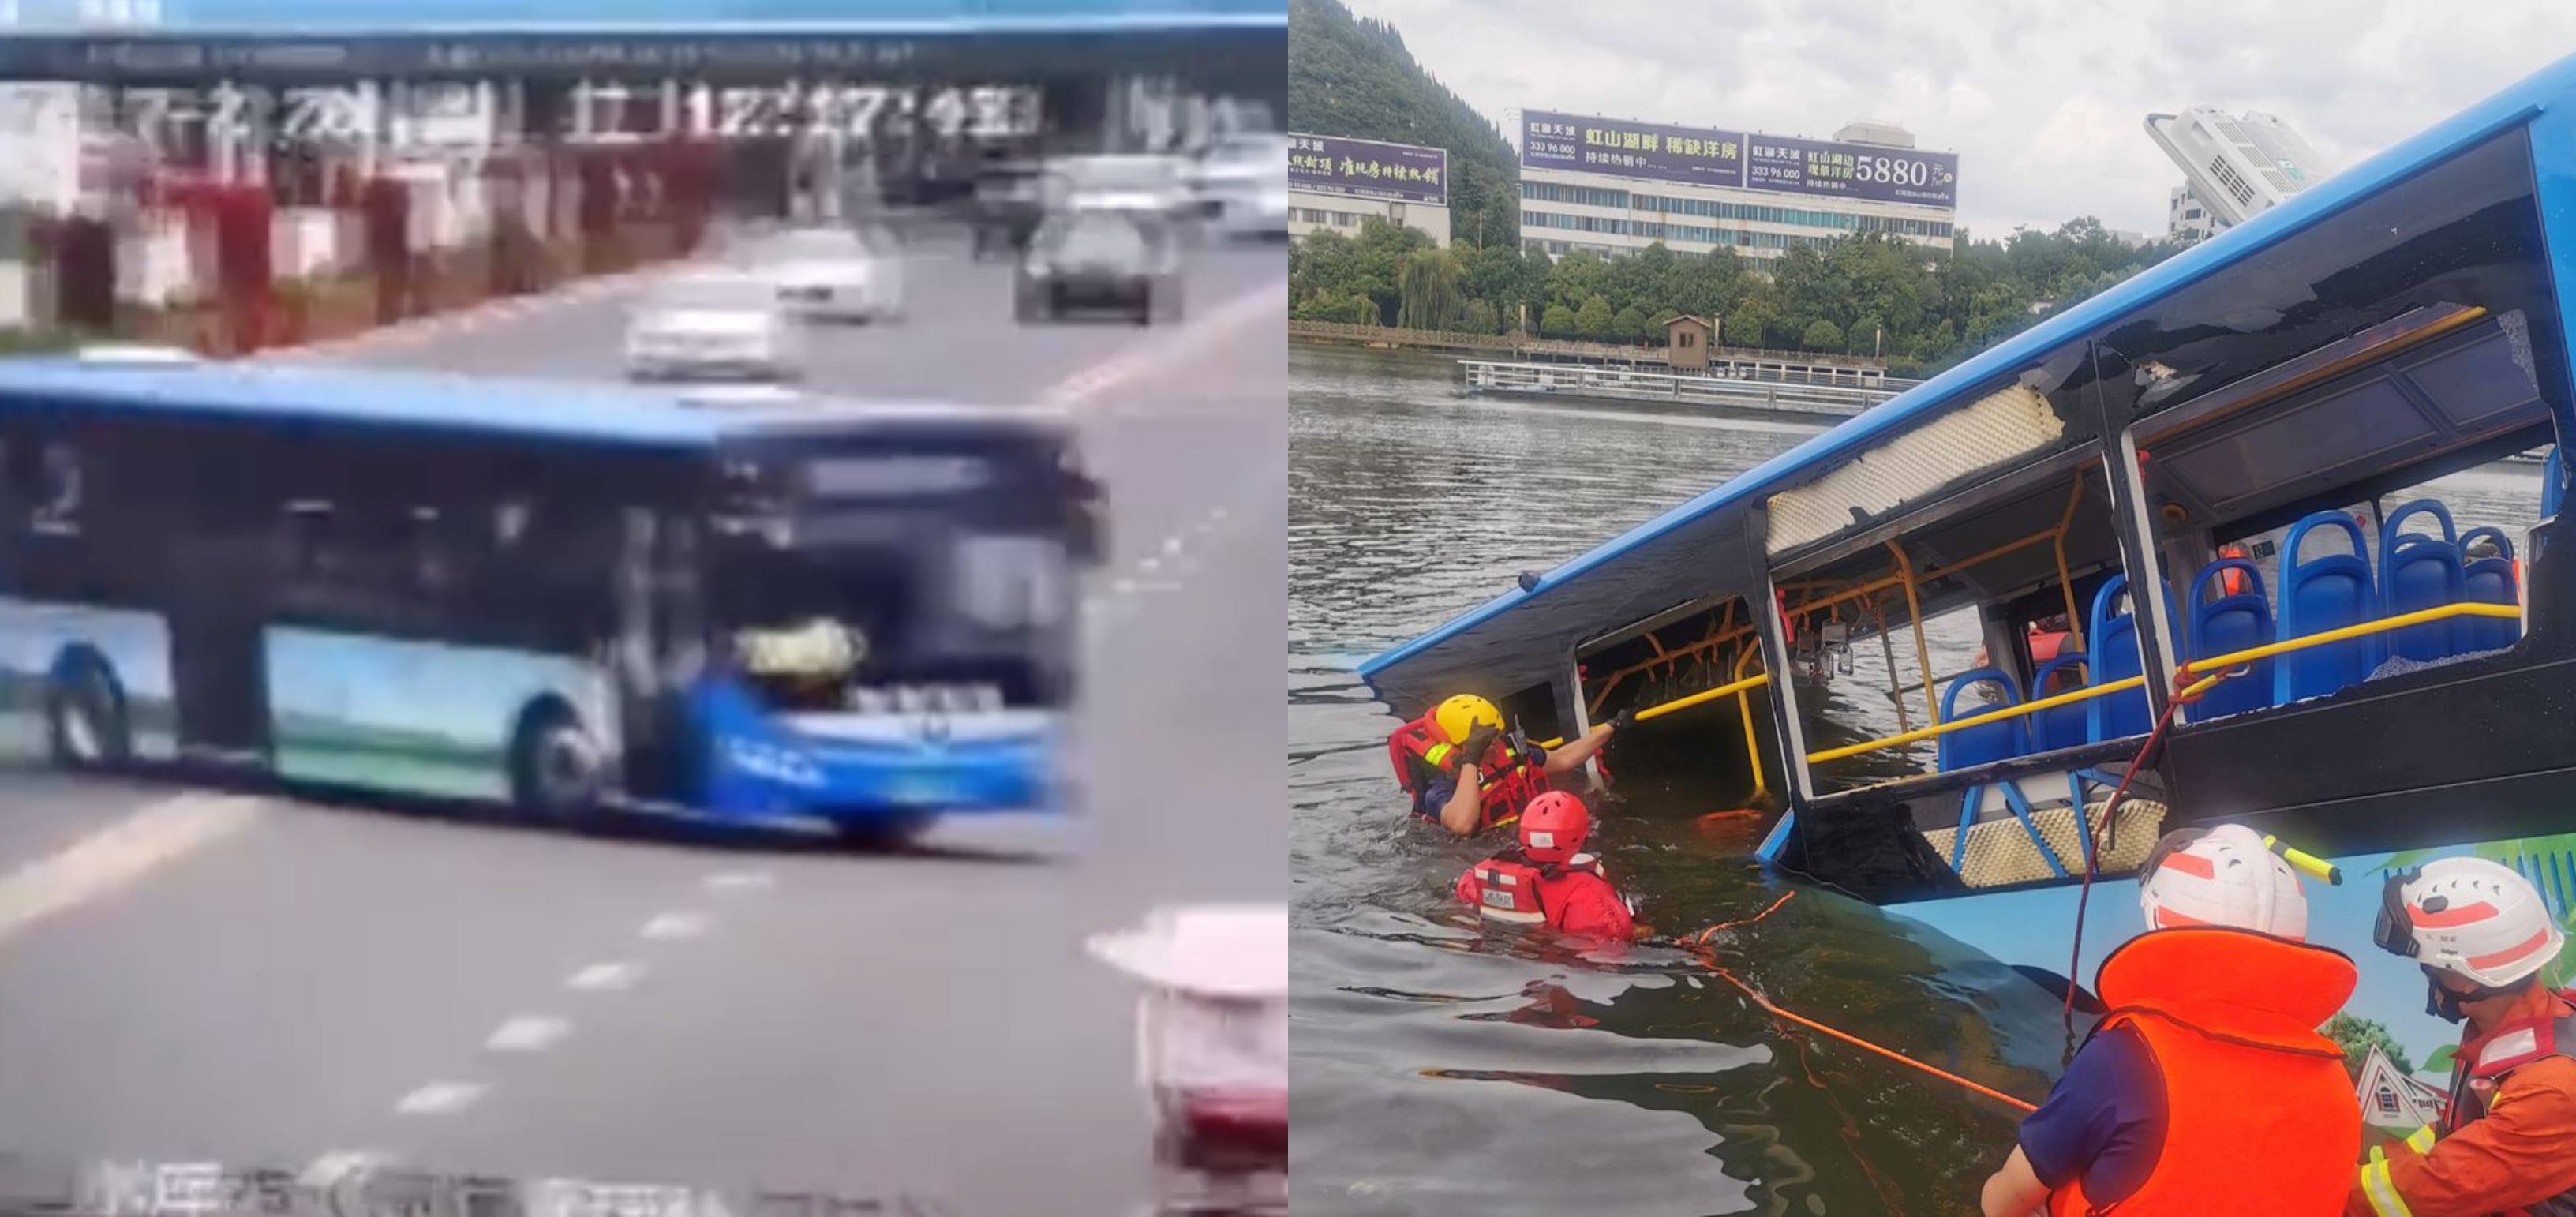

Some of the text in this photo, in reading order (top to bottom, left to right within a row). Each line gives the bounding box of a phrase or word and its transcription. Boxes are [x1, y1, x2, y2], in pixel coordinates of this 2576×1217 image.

[1530, 141, 1576, 154] 333 96 000
[1586, 127, 1738, 160] 虹山湖畔 稀缺洋房
[1751, 165, 1801, 180] 333 96 000
[1856, 155, 1927, 186] 5880
